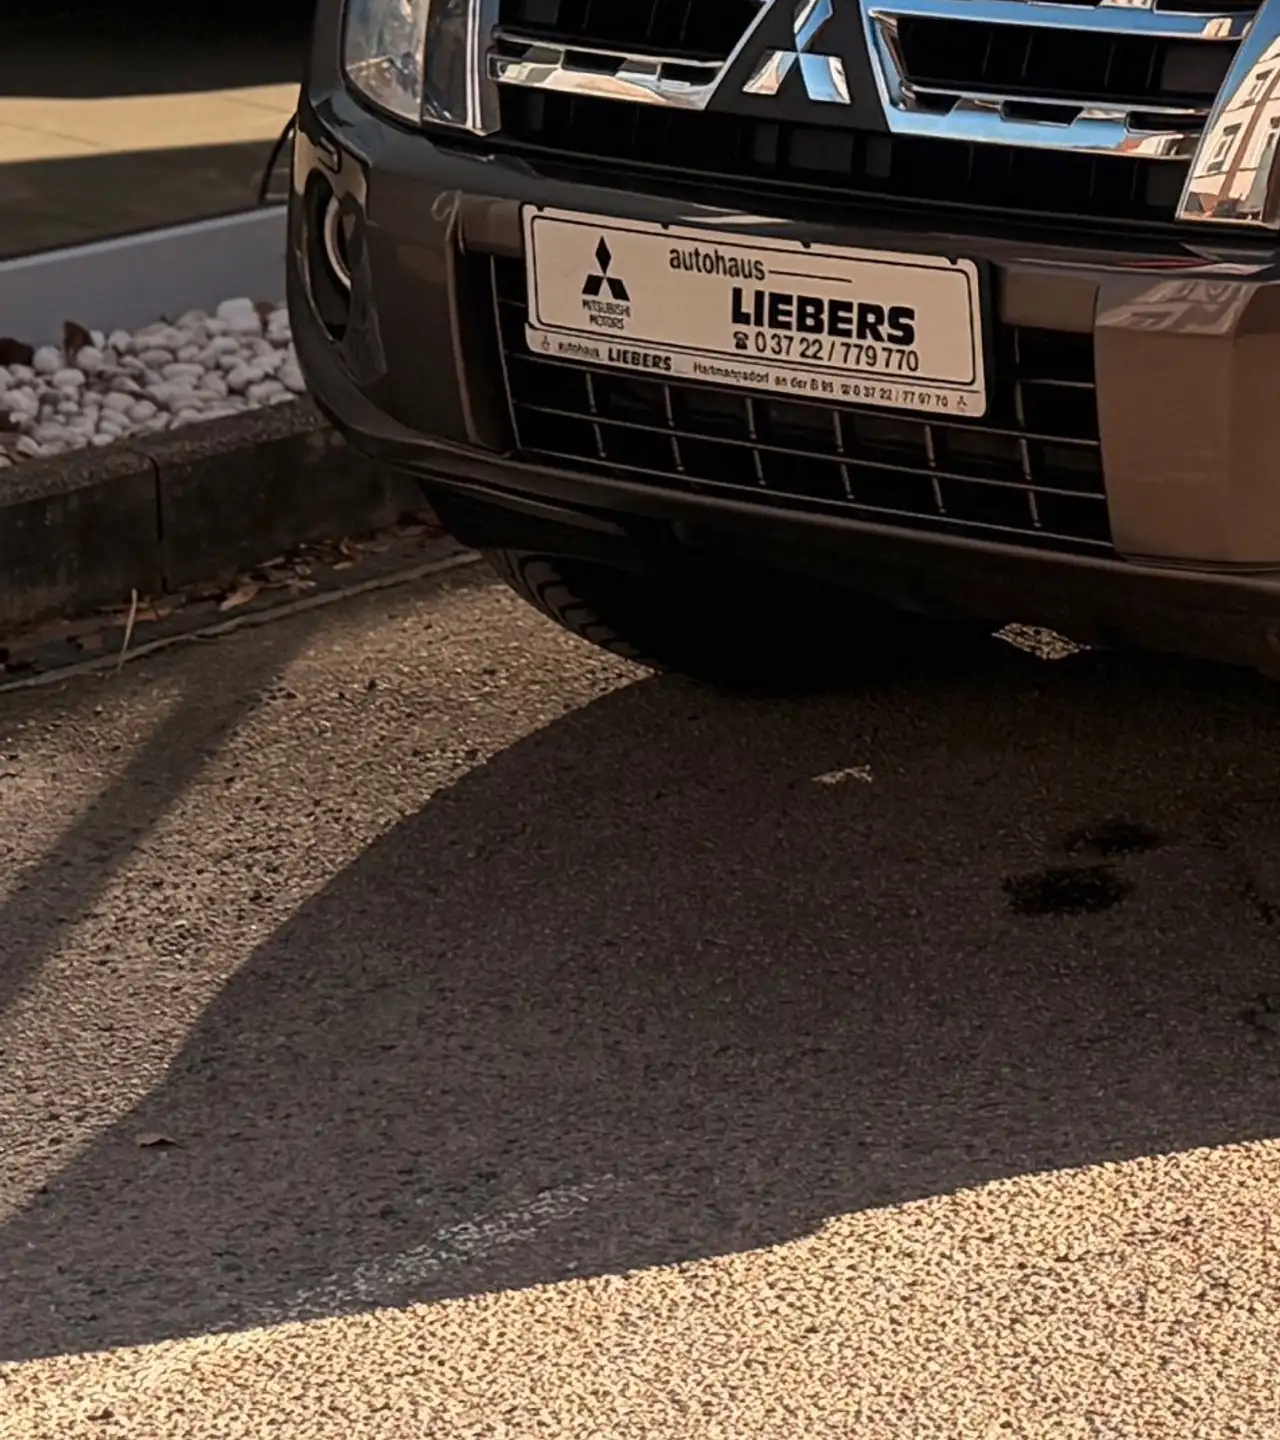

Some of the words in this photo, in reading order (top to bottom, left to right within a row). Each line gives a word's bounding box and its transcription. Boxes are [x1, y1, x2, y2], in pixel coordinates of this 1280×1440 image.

[669, 246, 766, 281] autohaus
[732, 286, 916, 347] LIEBERS
[608, 346, 672, 372] LIEBERS
